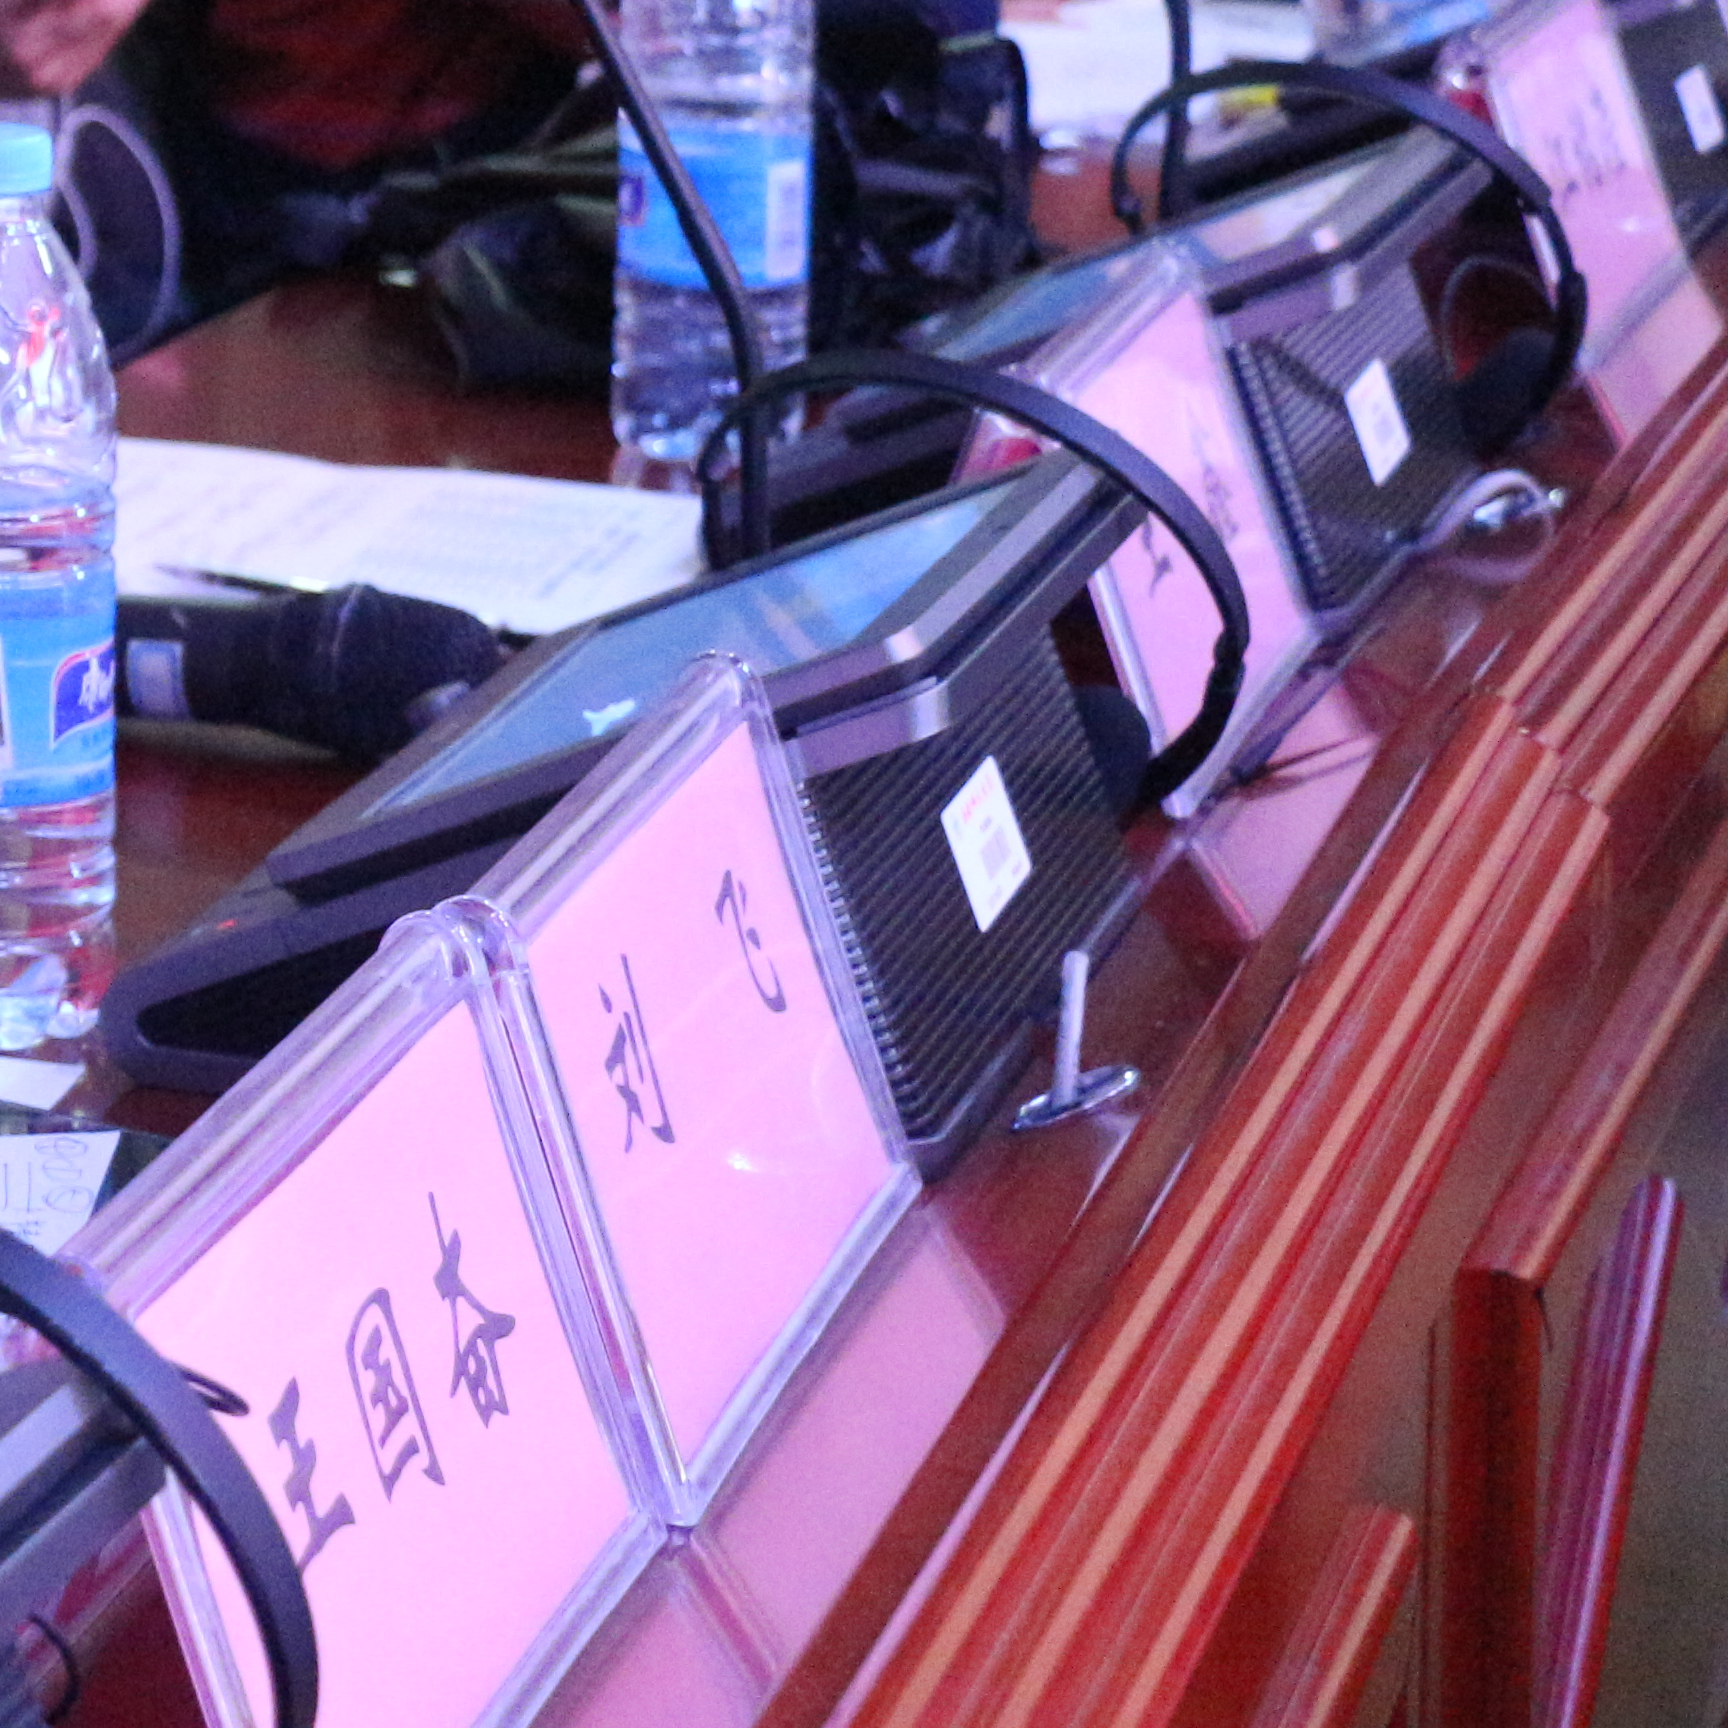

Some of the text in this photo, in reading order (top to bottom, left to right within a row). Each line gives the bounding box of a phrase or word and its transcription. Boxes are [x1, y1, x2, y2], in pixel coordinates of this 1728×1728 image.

[597, 869, 787, 1154] 刘飞
[268, 1190, 516, 1576] 王国奋
